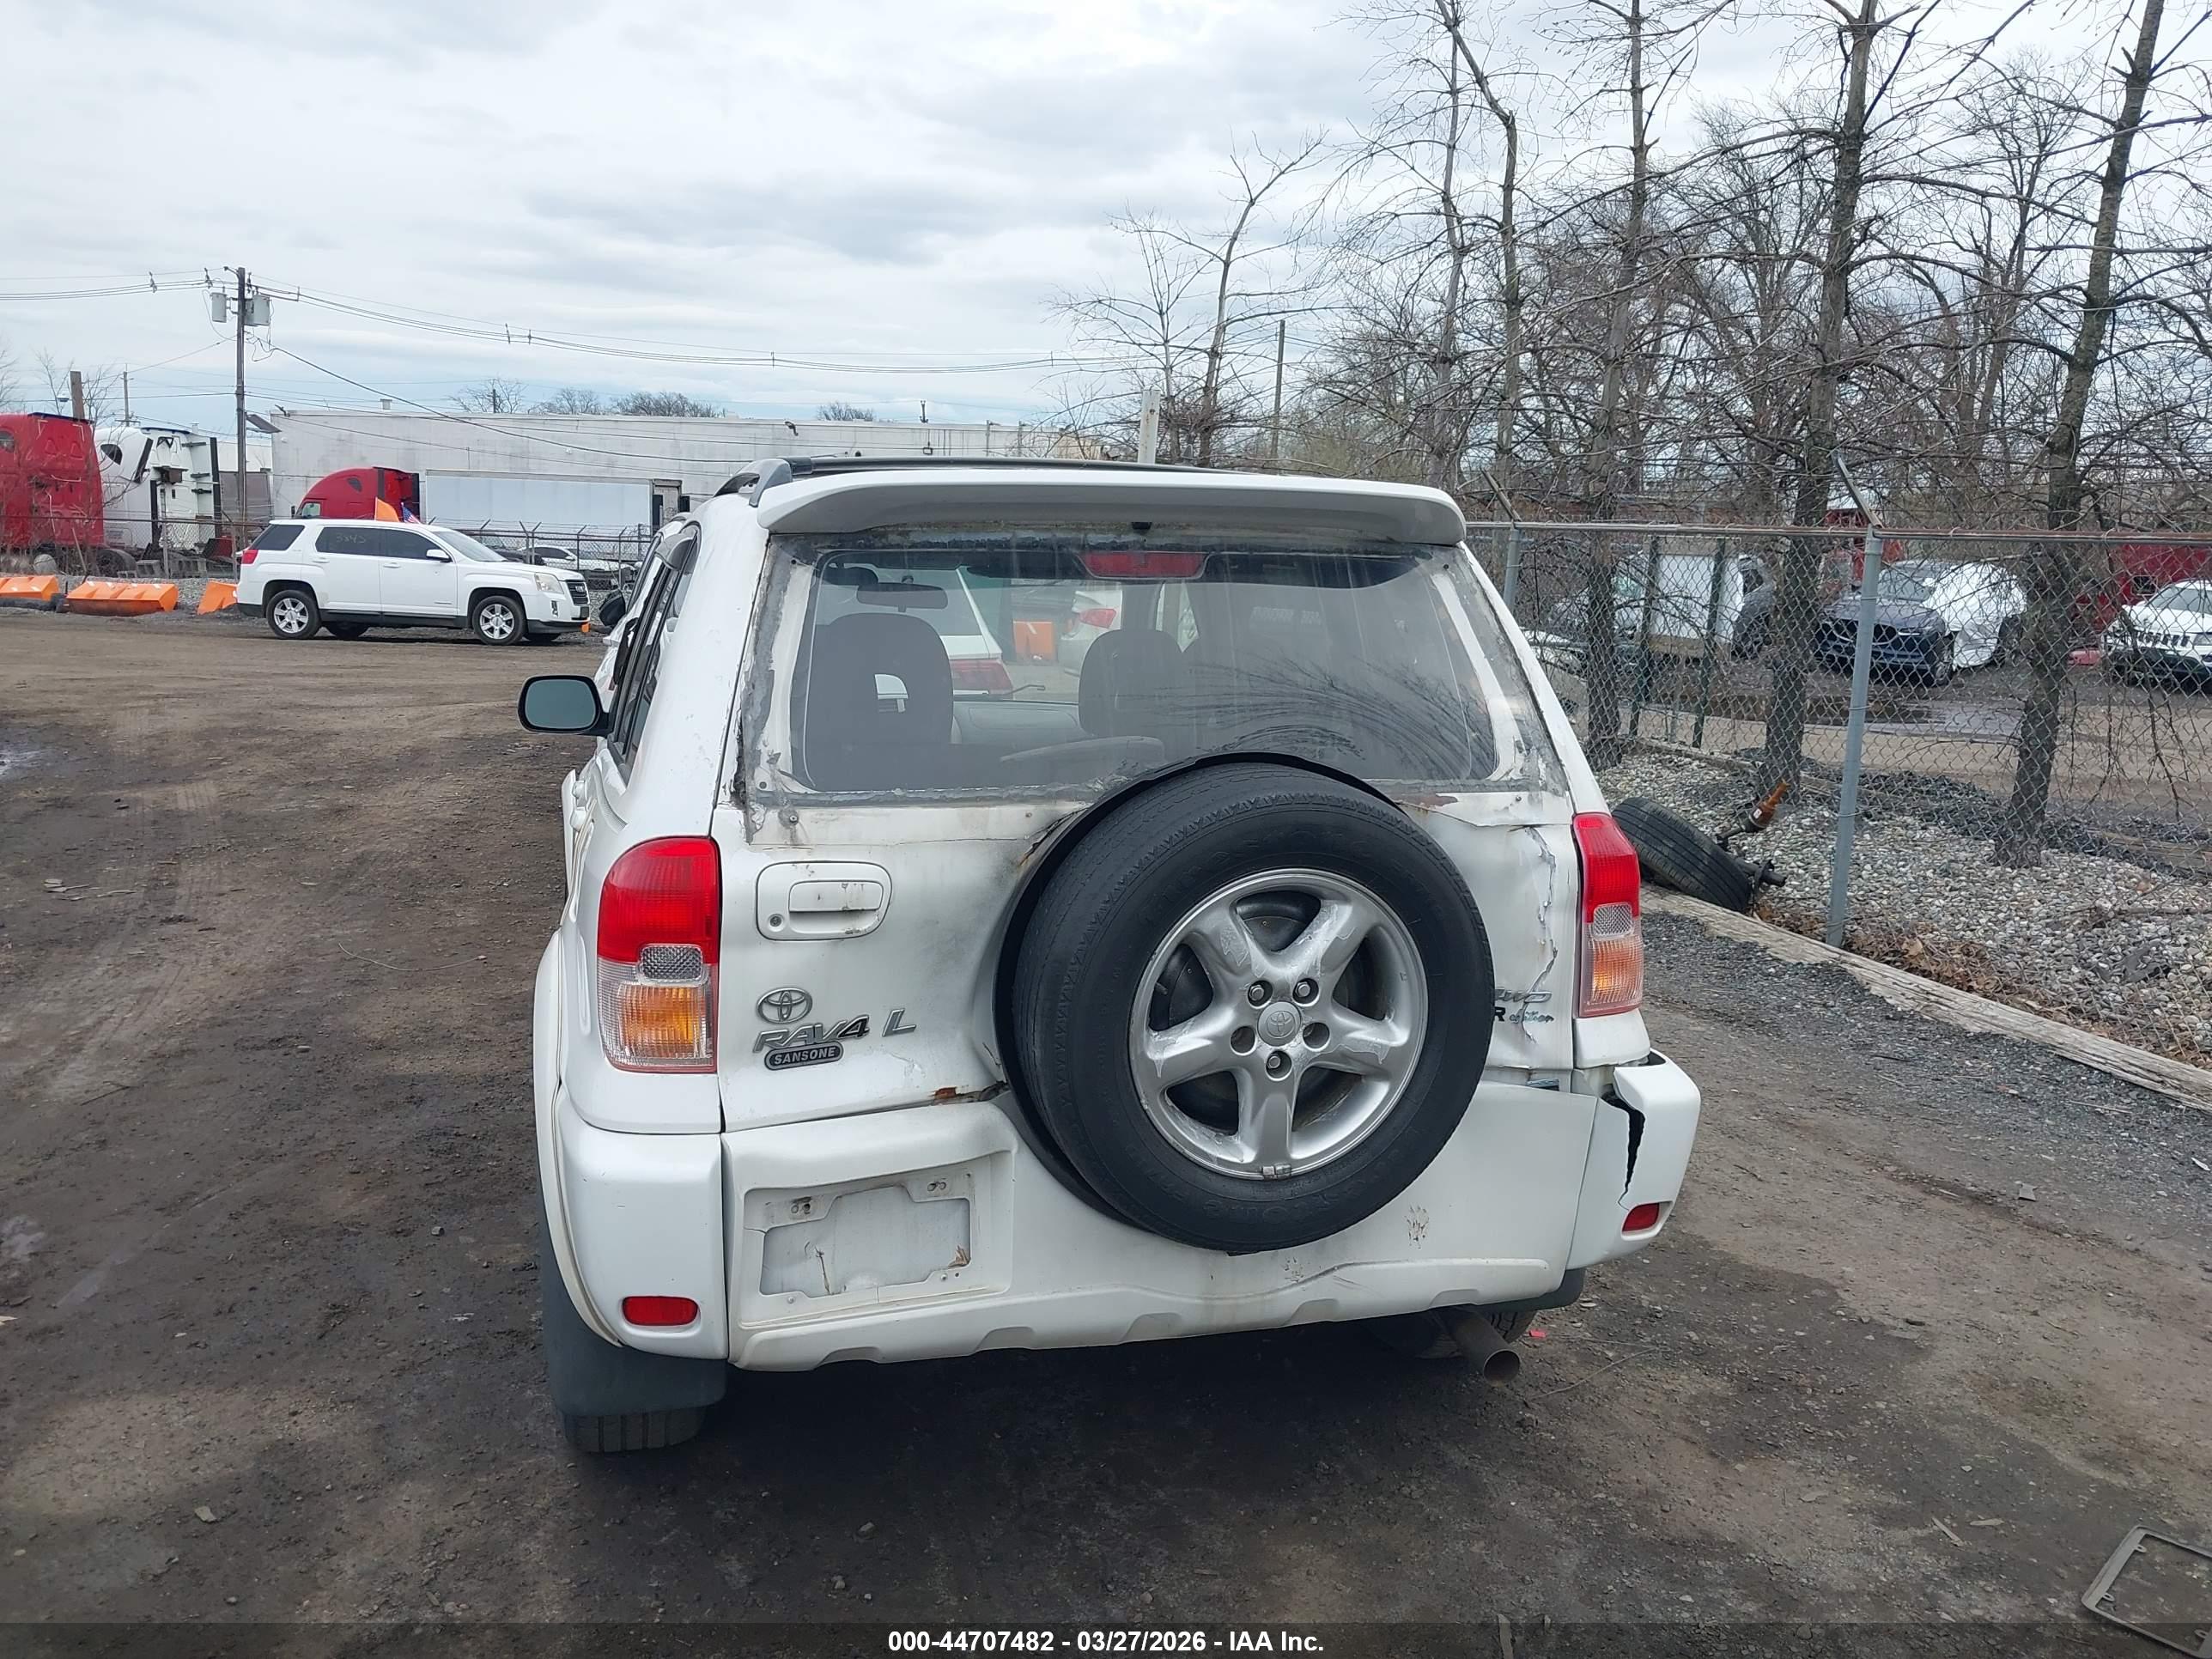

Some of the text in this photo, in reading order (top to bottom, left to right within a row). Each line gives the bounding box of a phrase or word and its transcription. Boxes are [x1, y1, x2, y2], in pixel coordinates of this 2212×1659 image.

[752, 1008, 916, 1053] RAV4 L
[774, 1047, 836, 1065] SANSONE
